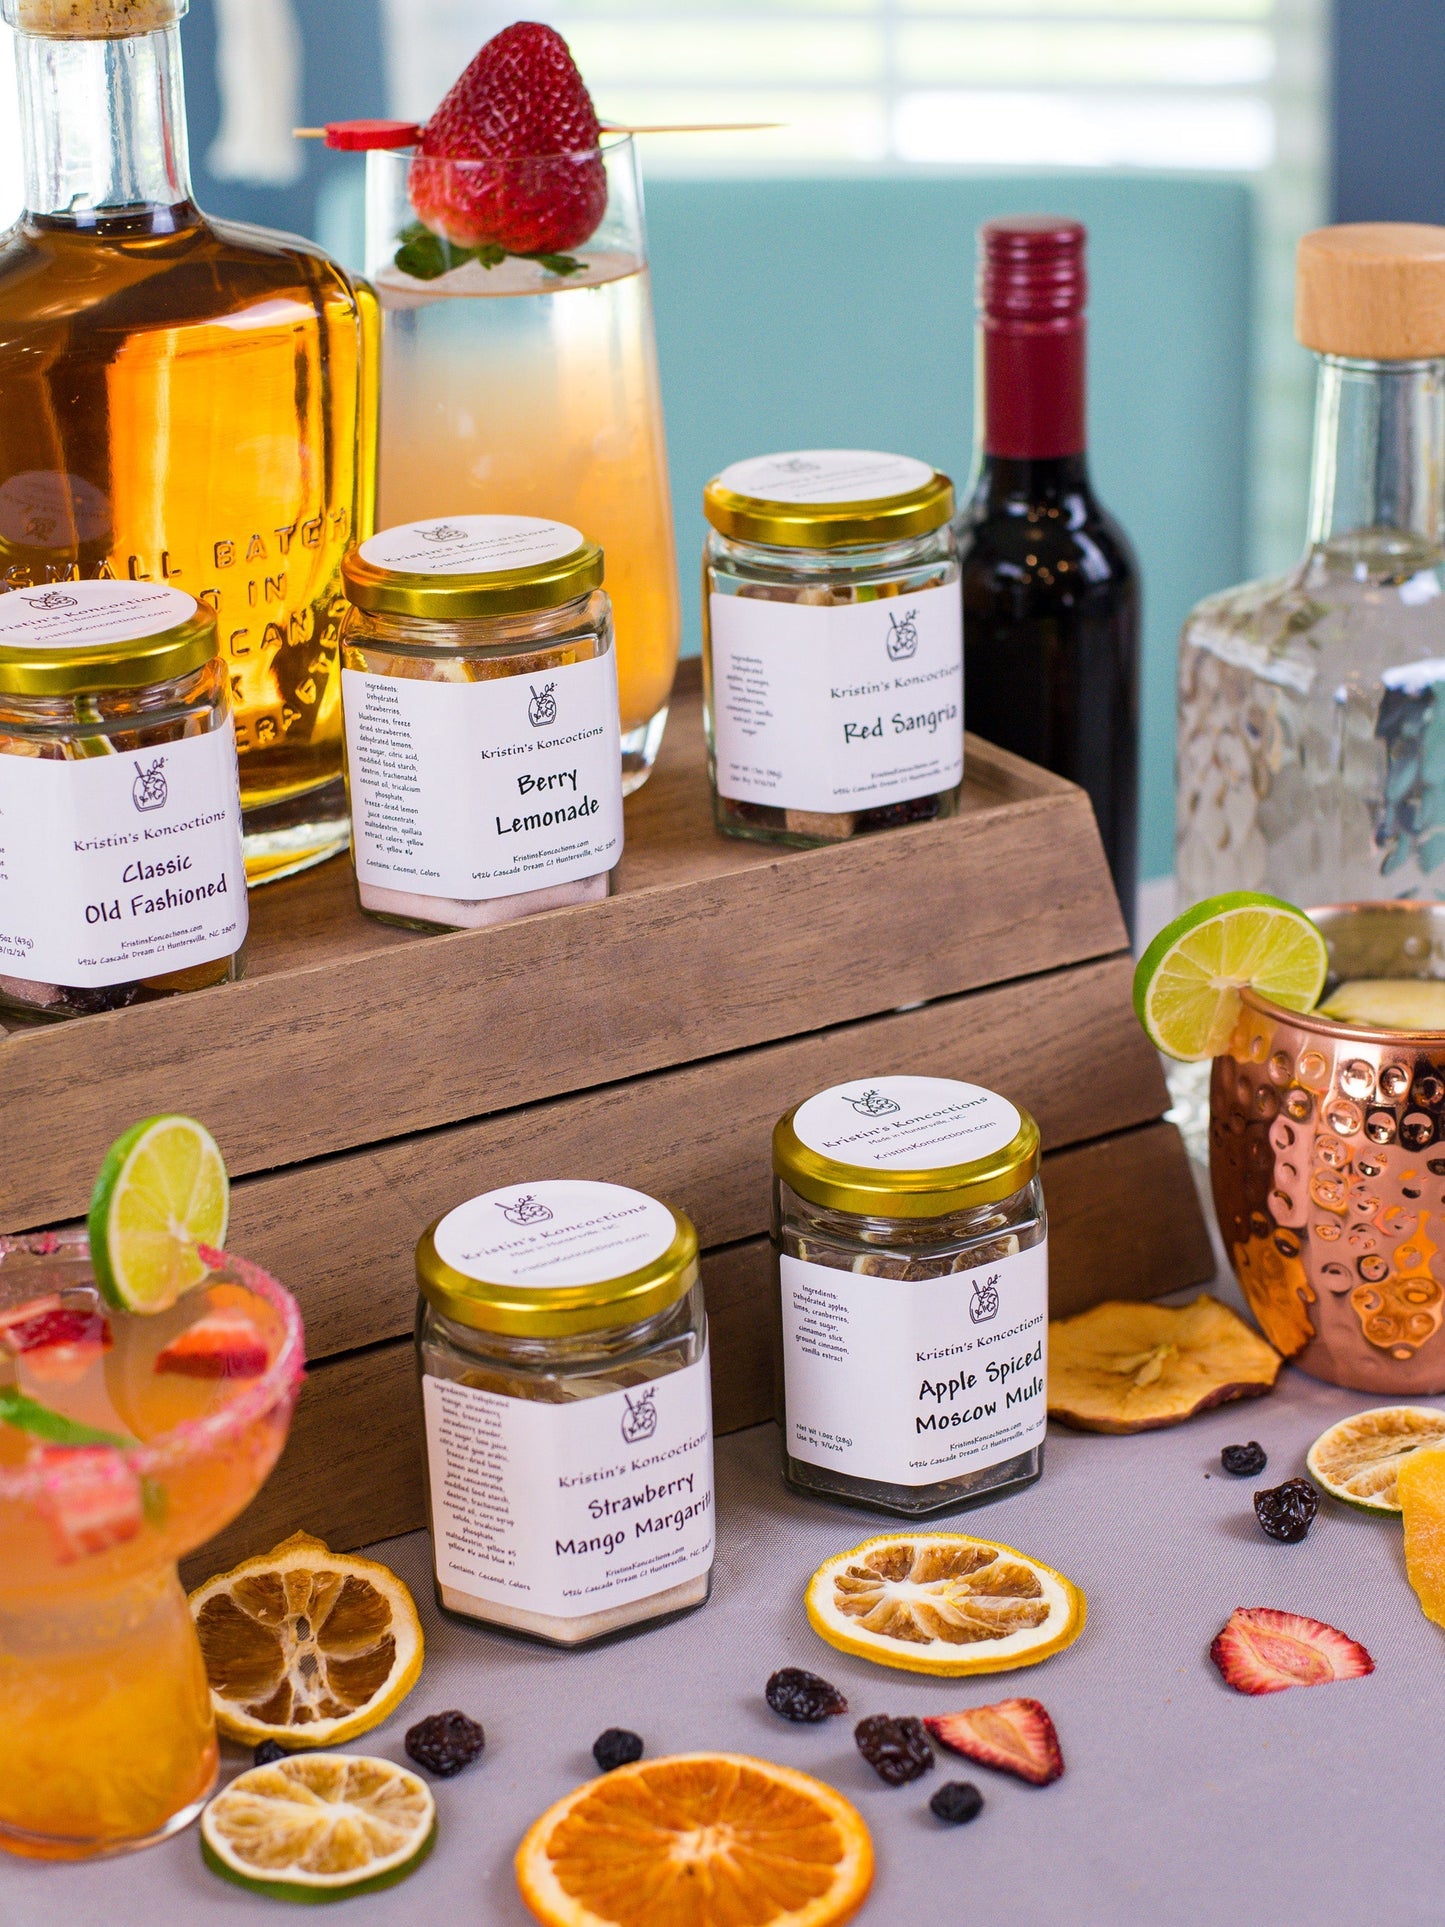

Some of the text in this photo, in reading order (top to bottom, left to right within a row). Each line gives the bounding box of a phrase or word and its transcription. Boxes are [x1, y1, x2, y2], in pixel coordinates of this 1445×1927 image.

[213, 508, 348, 570] BATCH
[248, 572, 288, 607] IN
[0, 592, 172, 633] ristin's Koncoctions
[830, 663, 960, 698] Kristin's Koncoction
[365, 704, 402, 716] strawberries,
[366, 692, 398, 704] Dehydrated
[358, 712, 410, 728] blueberries, freeze
[360, 724, 412, 740] dried strawberries,
[844, 704, 957, 744] Red Sangria
[360, 734, 413, 750] dehydrated lemons,
[481, 726, 604, 760] Kristin's Koncoctions
[382, 760, 395, 768] food
[398, 762, 418, 772] starch,
[405, 754, 419, 762] acid,
[360, 778, 380, 786] coconut
[392, 784, 420, 793] tricalcium
[382, 770, 418, 782] fractionated
[517, 768, 578, 796] Berry
[364, 798, 418, 814] freeze-dried lemon
[375, 791, 404, 802] phosphate,
[368, 810, 416, 825] juice concentrate,
[496, 794, 600, 836] Lemonade
[74, 810, 226, 852] Kristin's Koncoctions
[406, 838, 424, 847] yellow
[386, 846, 402, 855] yellow
[472, 871, 491, 880] 6926
[493, 866, 520, 878] Cascade
[523, 862, 544, 872] Dream
[546, 859, 554, 867] Ct
[556, 850, 593, 864] Huntersville,
[594, 846, 604, 854] NC
[513, 840, 590, 864] KristinsKoncoctions.com
[122, 854, 193, 884] Classic
[420, 868, 440, 878] Colors
[85, 872, 228, 924] Old Fashioned
[78, 957, 97, 966] 6926
[100, 952, 129, 964] Cascade
[132, 948, 155, 958] Dream
[157, 944, 166, 953] Ct
[168, 934, 207, 950] Huntersville,
[209, 928, 220, 938] NC
[121, 924, 203, 950] KristinsKoncoctions.com
[822, 1096, 989, 1148] Kristin's Koncoctions
[868, 1136, 892, 1146] Made
[901, 1118, 950, 1136] Huntersville,
[950, 1113, 967, 1121] NC
[874, 1121, 998, 1161] KristinsKoncoctions.com
[461, 1236, 536, 1260] Kristin's
[540, 1204, 648, 1239] Koncoctions
[792, 1292, 850, 1314] Dehydrated apples,
[802, 1284, 838, 1300] Ingredients:
[794, 1302, 850, 1324] limes, cranberries,
[804, 1316, 839, 1332] cane sugar,
[796, 1334, 850, 1354] ground cinnamon,
[798, 1324, 845, 1344] cinnamon stick,
[916, 1313, 1044, 1362] Kristin's Koncoctions
[802, 1345, 843, 1363] vanilla extract
[918, 1340, 1042, 1404] Apple Spiced
[916, 1376, 1044, 1434] Moscow Mule
[796, 1423, 807, 1433] Net
[808, 1428, 817, 1436] Wt
[836, 1434, 853, 1447] (28g)
[796, 1432, 808, 1442] Use
[808, 1436, 818, 1448] By
[908, 1460, 928, 1468] 6926
[930, 1454, 956, 1465] Cascade
[959, 1446, 979, 1458] Dream
[990, 1430, 1024, 1448] Huntersville,
[1026, 1424, 1036, 1432] NC
[950, 1422, 1022, 1452] KristinsKoncoctions.com
[559, 1432, 709, 1488] Kristin's Koncoction
[588, 1472, 694, 1520] Strawberry
[555, 1530, 626, 1557] Mango
[563, 1588, 582, 1598] 6926
[585, 1581, 613, 1594] Cascade
[616, 1574, 638, 1585] Dream
[650, 1555, 688, 1574] Huntersville,
[690, 1548, 700, 1558] NC
[606, 1546, 685, 1578] KristinsKoncoctions.com
[508, 1580, 531, 1591] Colors
